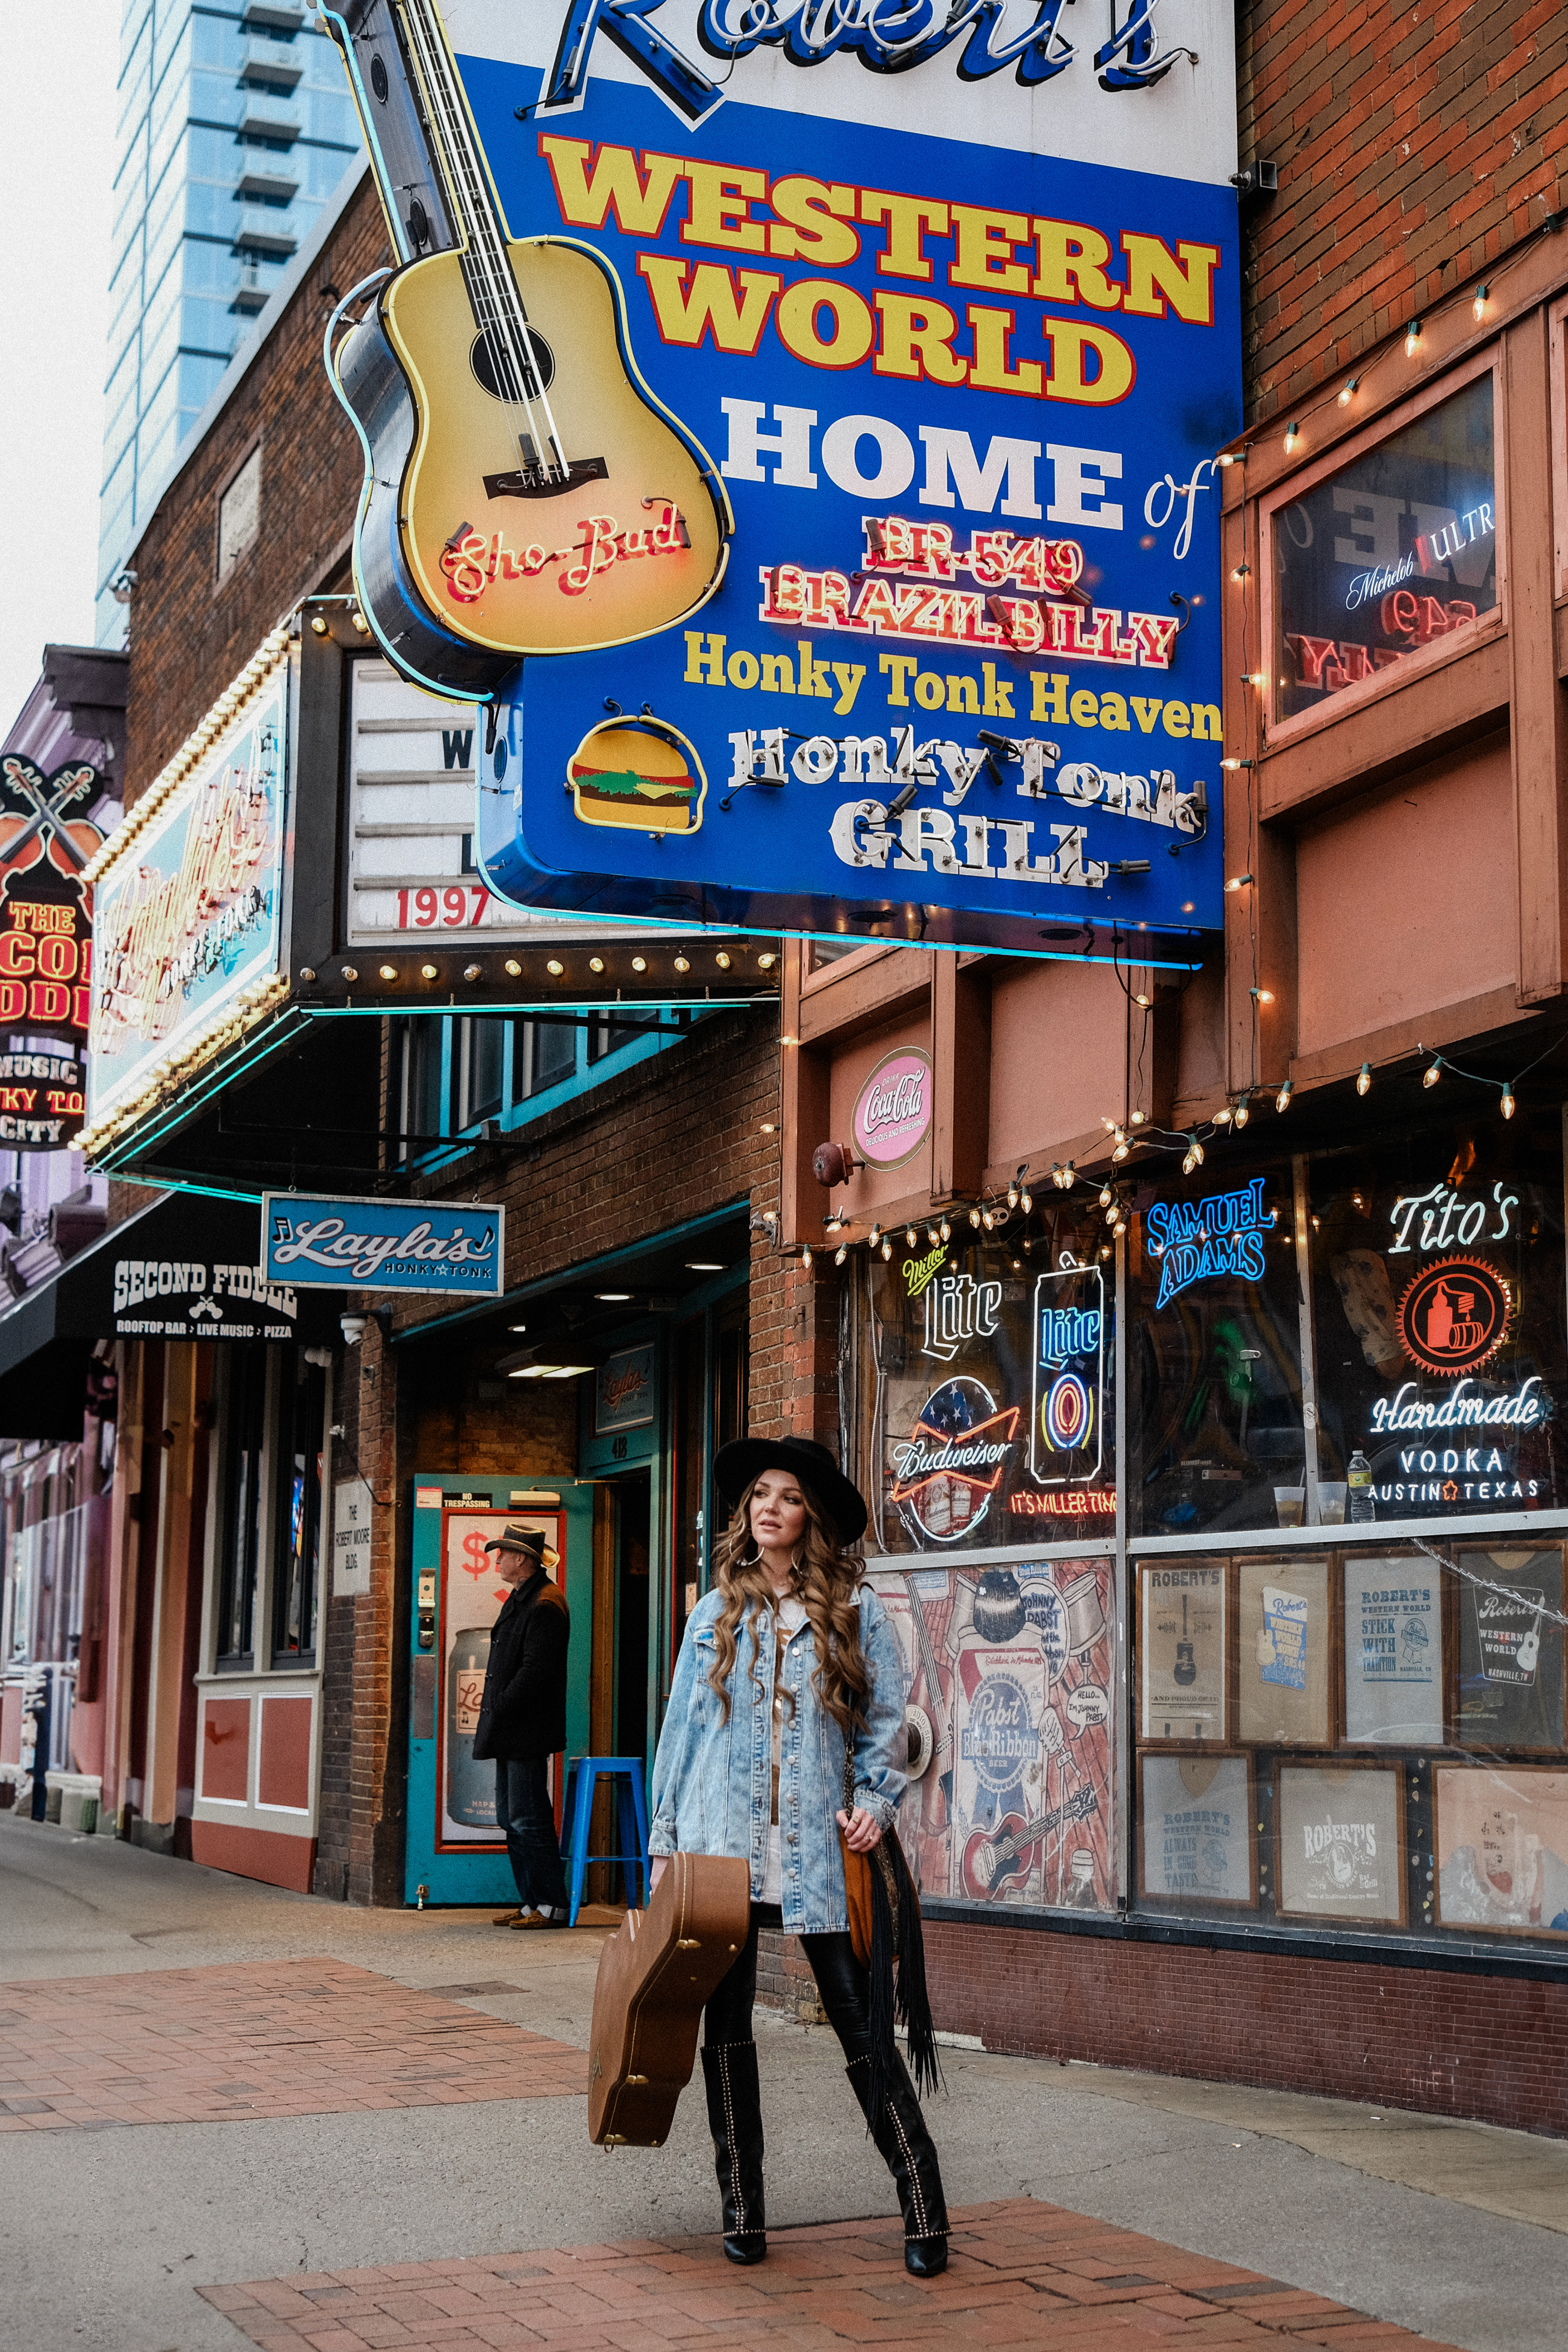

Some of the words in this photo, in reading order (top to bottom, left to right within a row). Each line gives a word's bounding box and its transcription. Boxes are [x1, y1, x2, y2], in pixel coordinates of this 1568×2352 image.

[538, 131, 1221, 327] WESTERN
[636, 250, 1136, 407] WORLD
[721, 396, 1123, 531] HOME
[1144, 459, 1216, 560] of
[445, 503, 681, 604] Sho-Bud
[862, 515, 1084, 595] BR-549
[1345, 550, 1414, 610] Michelob
[1430, 502, 1495, 561] ULTR
[684, 630, 866, 715] Honky
[879, 654, 1016, 719] Tonk
[1029, 671, 1223, 742] Heaven
[728, 724, 989, 806] Honky
[1008, 737, 1203, 834] Tonk
[829, 799, 1109, 888] GRILL
[9, 901, 76, 935] THE
[397, 887, 490, 928] 1997
[882, 1072, 900, 1087] DRINK
[864, 1067, 926, 1134] Coca-Cola
[866, 1132, 888, 1147] DELICIOUS
[889, 1128, 898, 1139] AND
[899, 1117, 925, 1134] REFRESHING
[1147, 1177, 1275, 1255] SAMUEL
[1388, 1181, 1519, 1254] Tito's
[273, 1216, 492, 1279] Layla's
[385, 1263, 438, 1276] HONKY
[450, 1267, 492, 1278] TONK
[902, 1244, 949, 1292] Miller
[1156, 1231, 1265, 1309] ADAMS
[114, 1260, 207, 1314] SECOND
[116, 1319, 164, 1334] ROOFTOP
[165, 1321, 187, 1335] BAR
[197, 1323, 218, 1336] LIVE
[220, 1324, 254, 1337] MUSIC
[264, 1325, 292, 1338] PIZZA
[921, 1274, 1002, 1361] Lite
[1039, 1307, 1101, 1370] Lite
[1370, 1376, 1543, 1433] Handmade
[893, 1438, 1012, 1478] Budweiser
[1401, 1448, 1503, 1474] VODKA
[444, 1500, 490, 1508] TRESPASSING
[1011, 1491, 1035, 1514] IT'S
[1036, 1492, 1088, 1513] MILLER
[1368, 1482, 1440, 1502] AUSTIN
[1464, 1479, 1539, 1500] TEXAS
[349, 1505, 357, 1520] THE
[1031, 1565, 1049, 1575] Rion
[1152, 1570, 1220, 1587] ROBERT'S
[1022, 1592, 1056, 1610] JOHNNY
[1361, 1589, 1430, 1604] ROBERT'S
[1361, 1605, 1400, 1614] WESTERN
[1479, 1596, 1538, 1619] Robert's
[1026, 1609, 1062, 1630] PABST
[1362, 1618, 1396, 1634] STICK
[1362, 1637, 1396, 1653] WITH
[1479, 1629, 1523, 1642] WESTERN
[1485, 1643, 1517, 1655] WORLD
[1363, 1656, 1396, 1672] TRADITION
[978, 1688, 1021, 1726] Pabst
[1078, 1691, 1100, 1699] HELLO...
[1078, 1704, 1100, 1714] JOHNNY
[1086, 1712, 1103, 1722] PABST
[991, 1730, 1037, 1757] Ribbon
[1164, 1811, 1230, 1826] ROBERT'S
[1304, 1823, 1376, 1858] ROBERT'S
